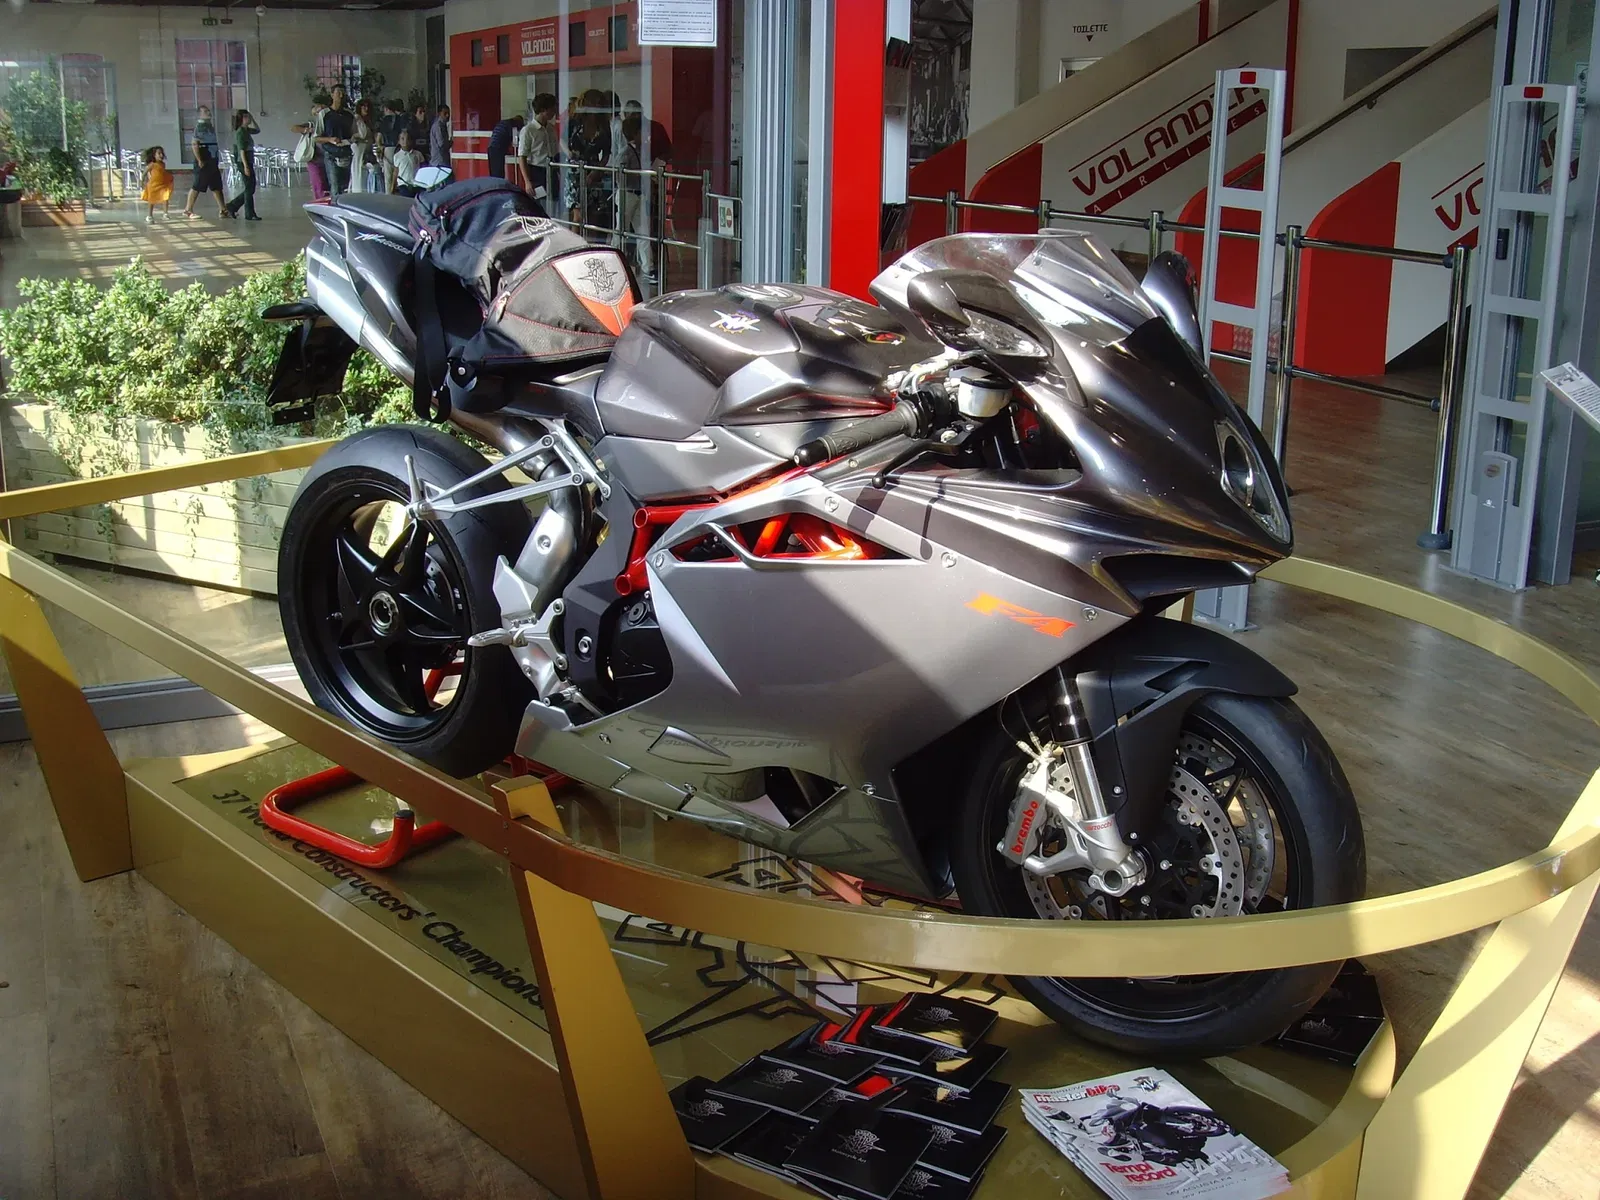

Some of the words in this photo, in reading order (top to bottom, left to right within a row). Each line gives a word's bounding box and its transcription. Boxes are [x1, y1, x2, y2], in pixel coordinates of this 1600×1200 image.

[1072, 23, 1109, 34] TOILETTE
[520, 36, 555, 55] VOLANDIA
[963, 589, 1077, 639] F4
[212, 789, 251, 804] 37
[1010, 800, 1040, 855] brembo
[1099, 1161, 1154, 1174] Tempi
[1123, 1166, 1178, 1183] record
